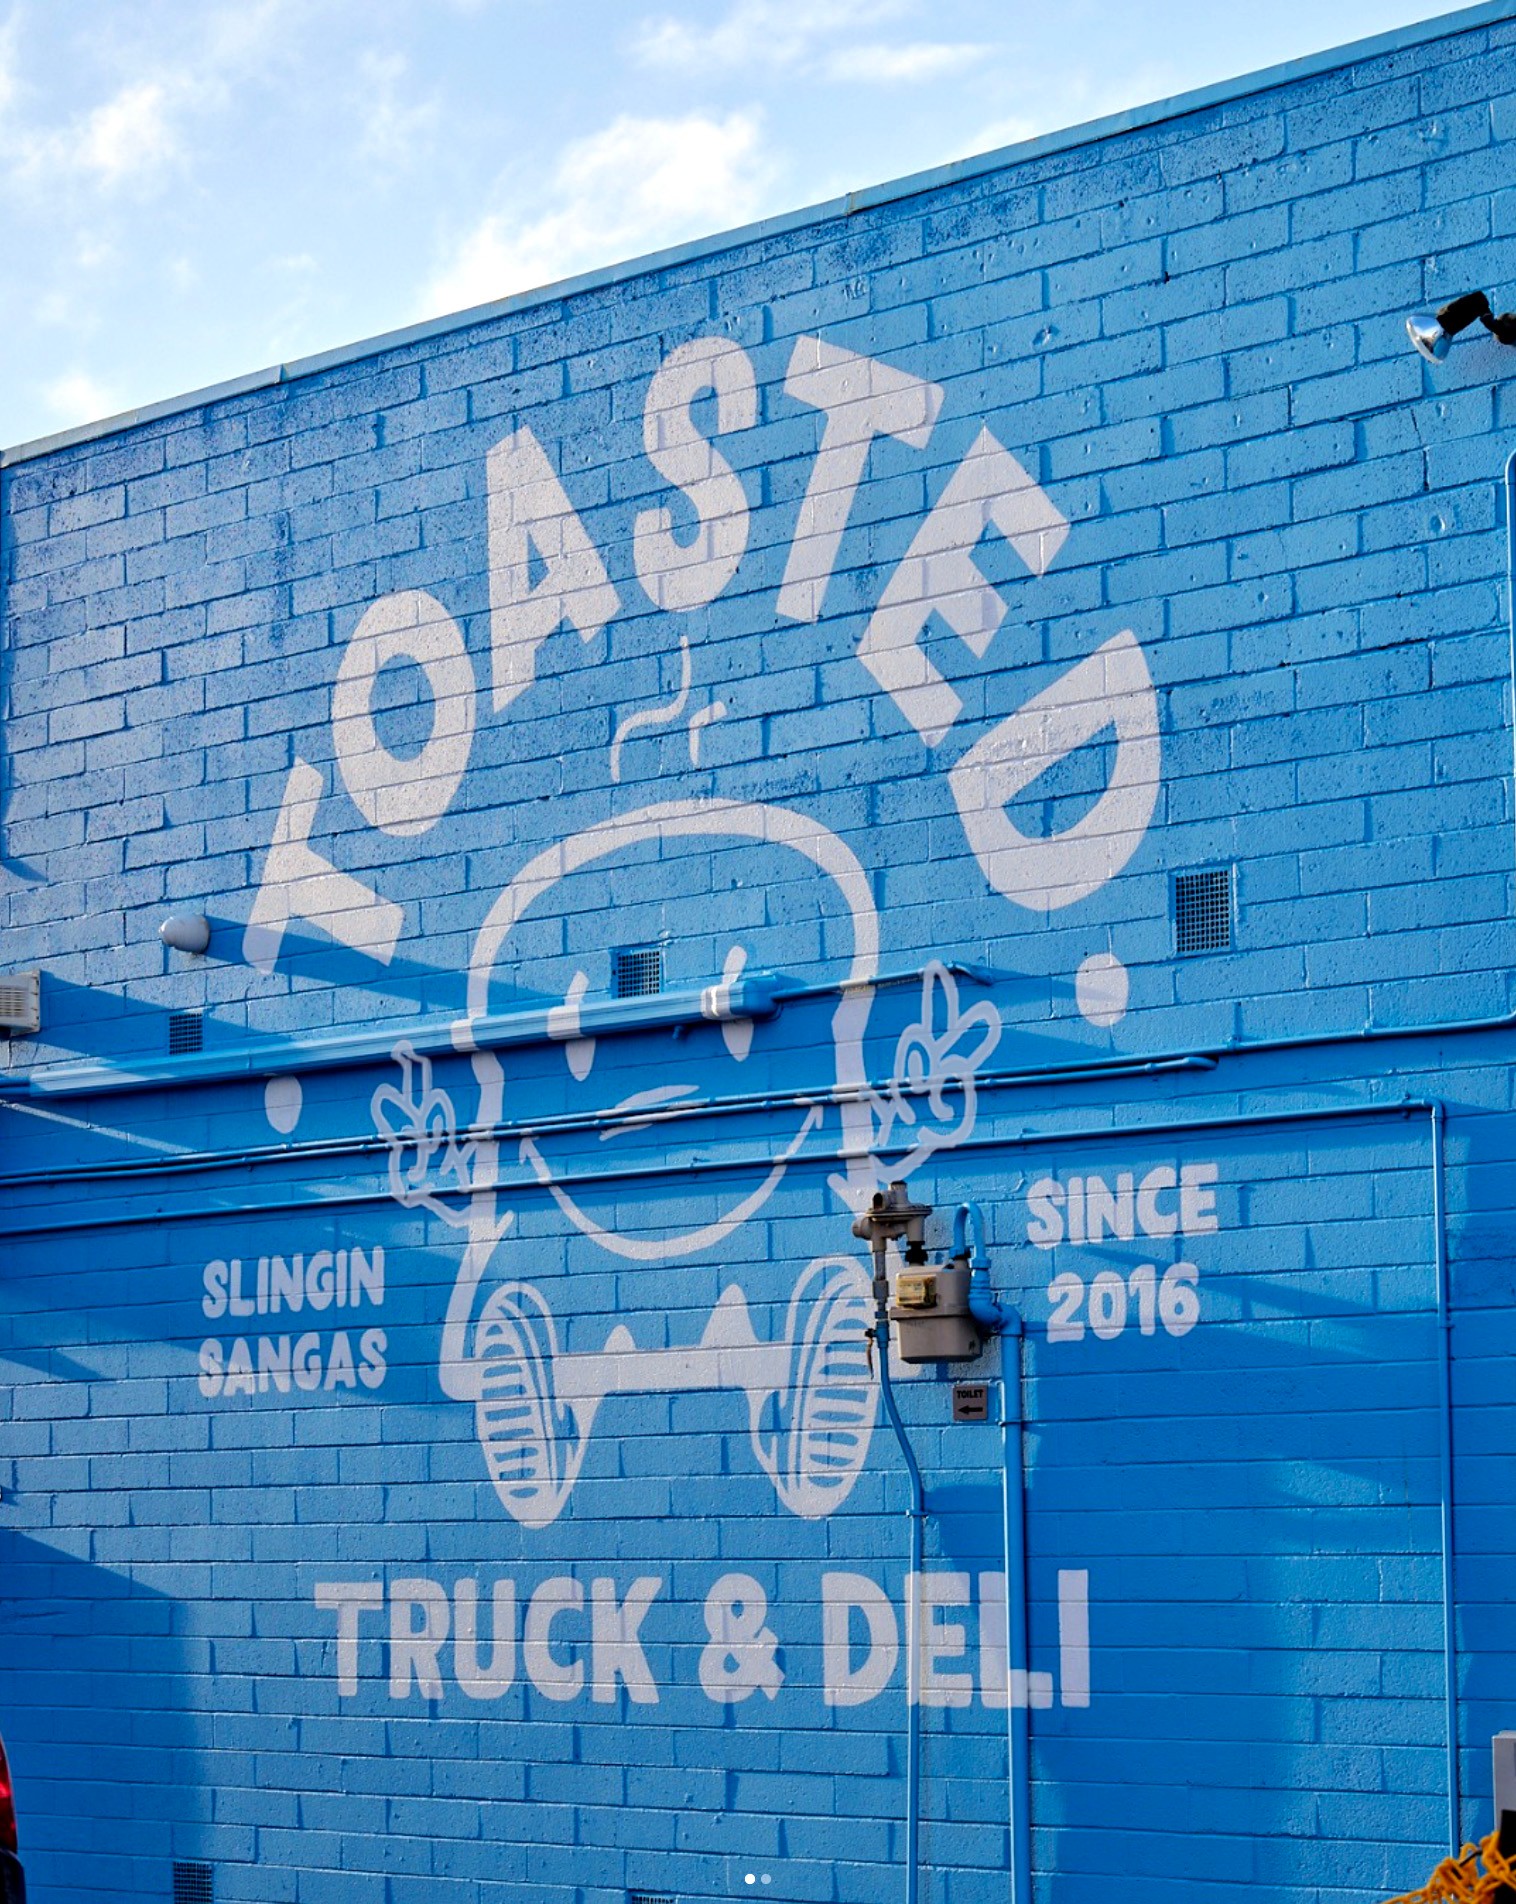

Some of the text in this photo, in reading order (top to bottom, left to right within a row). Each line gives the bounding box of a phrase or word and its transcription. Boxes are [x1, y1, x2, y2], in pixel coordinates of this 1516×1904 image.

[242, 335, 1162, 978] TOASTED
[1026, 1163, 1218, 1250] SINCE
[202, 1246, 386, 1319] SLINGIN
[1047, 1262, 1200, 1343] 2016
[199, 1328, 388, 1398] SANGAS
[956, 1388, 984, 1398] TOILET
[314, 1568, 1092, 1710] TRUCK & DELI
